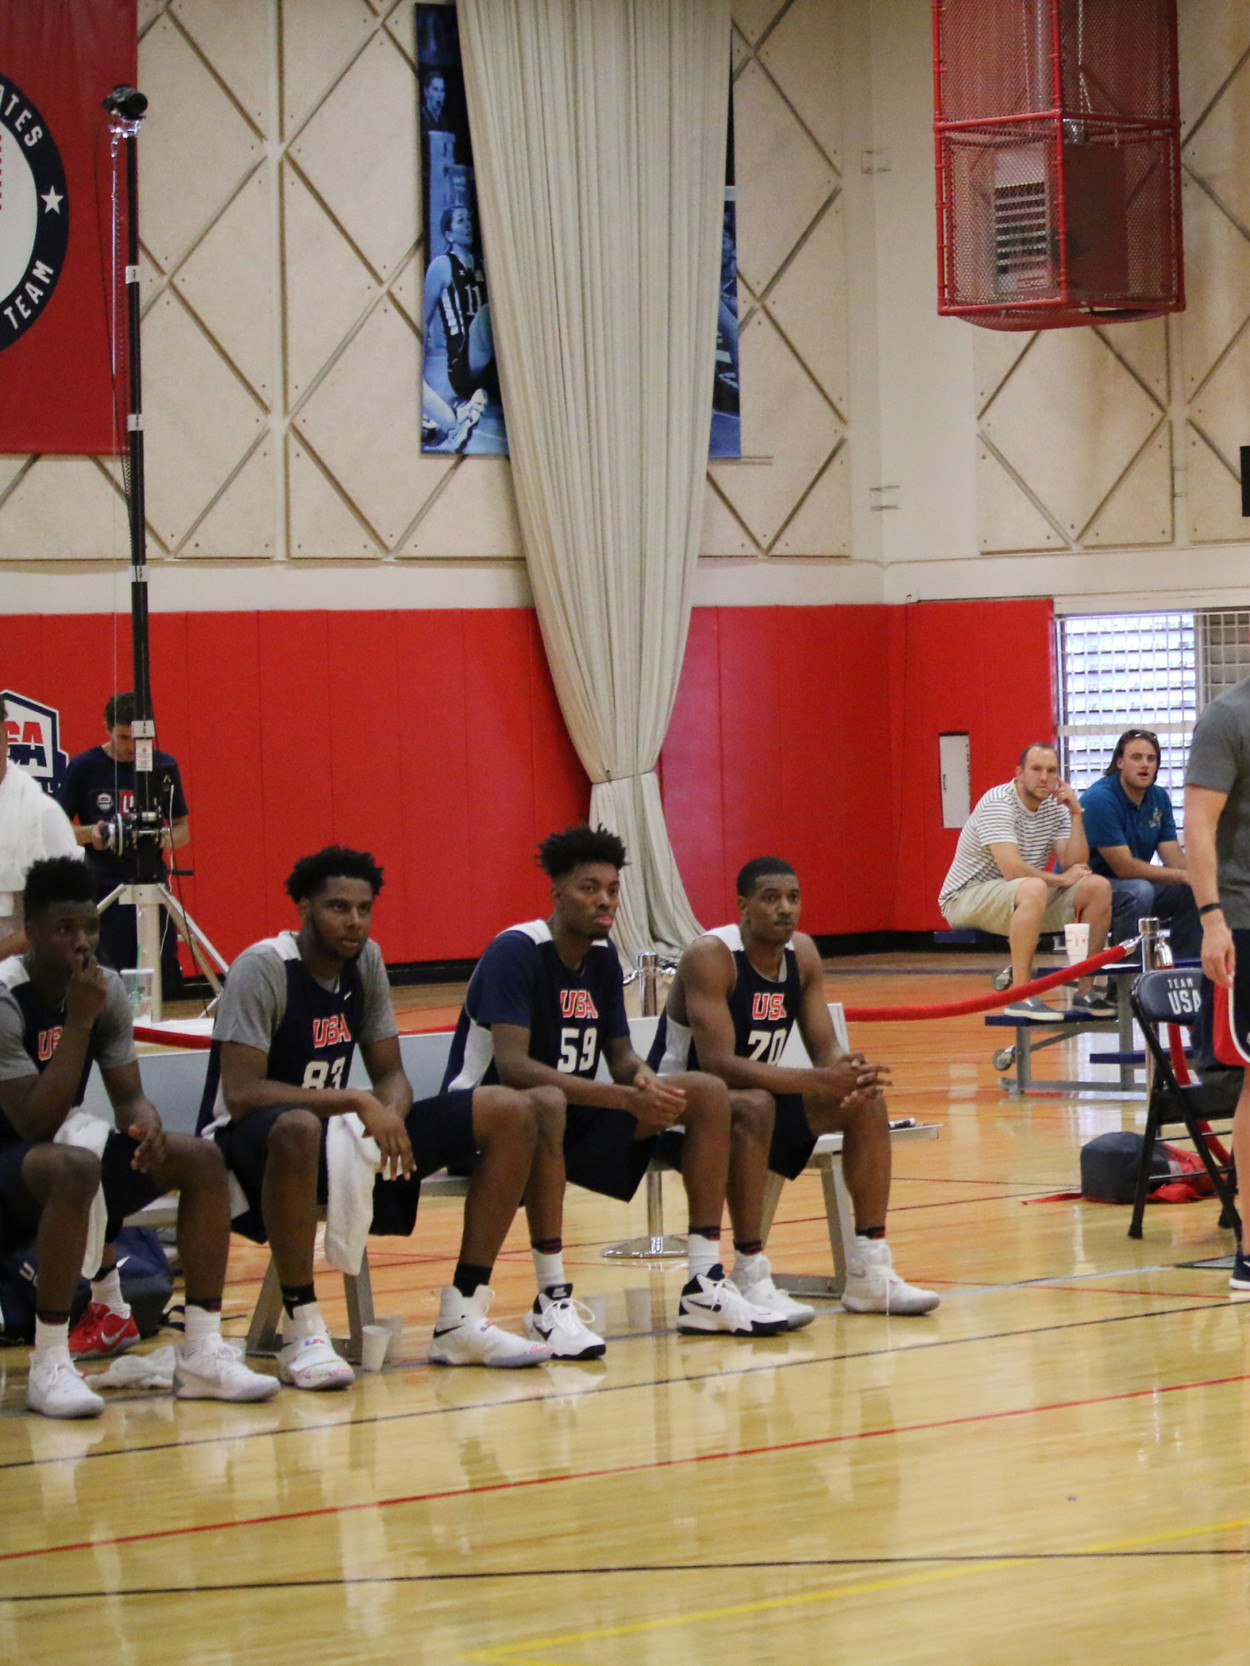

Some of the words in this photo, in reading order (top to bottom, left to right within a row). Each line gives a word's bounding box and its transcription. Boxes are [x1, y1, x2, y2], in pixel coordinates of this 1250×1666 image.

[4, 260, 54, 329] TEAM
[1168, 978, 1194, 988] TEAM
[560, 989, 598, 1019] USA
[1168, 989, 1202, 1015] USA
[39, 1025, 63, 1061] US
[313, 1013, 351, 1048] USA
[748, 1028, 787, 1066] 70
[557, 1027, 597, 1073] 59
